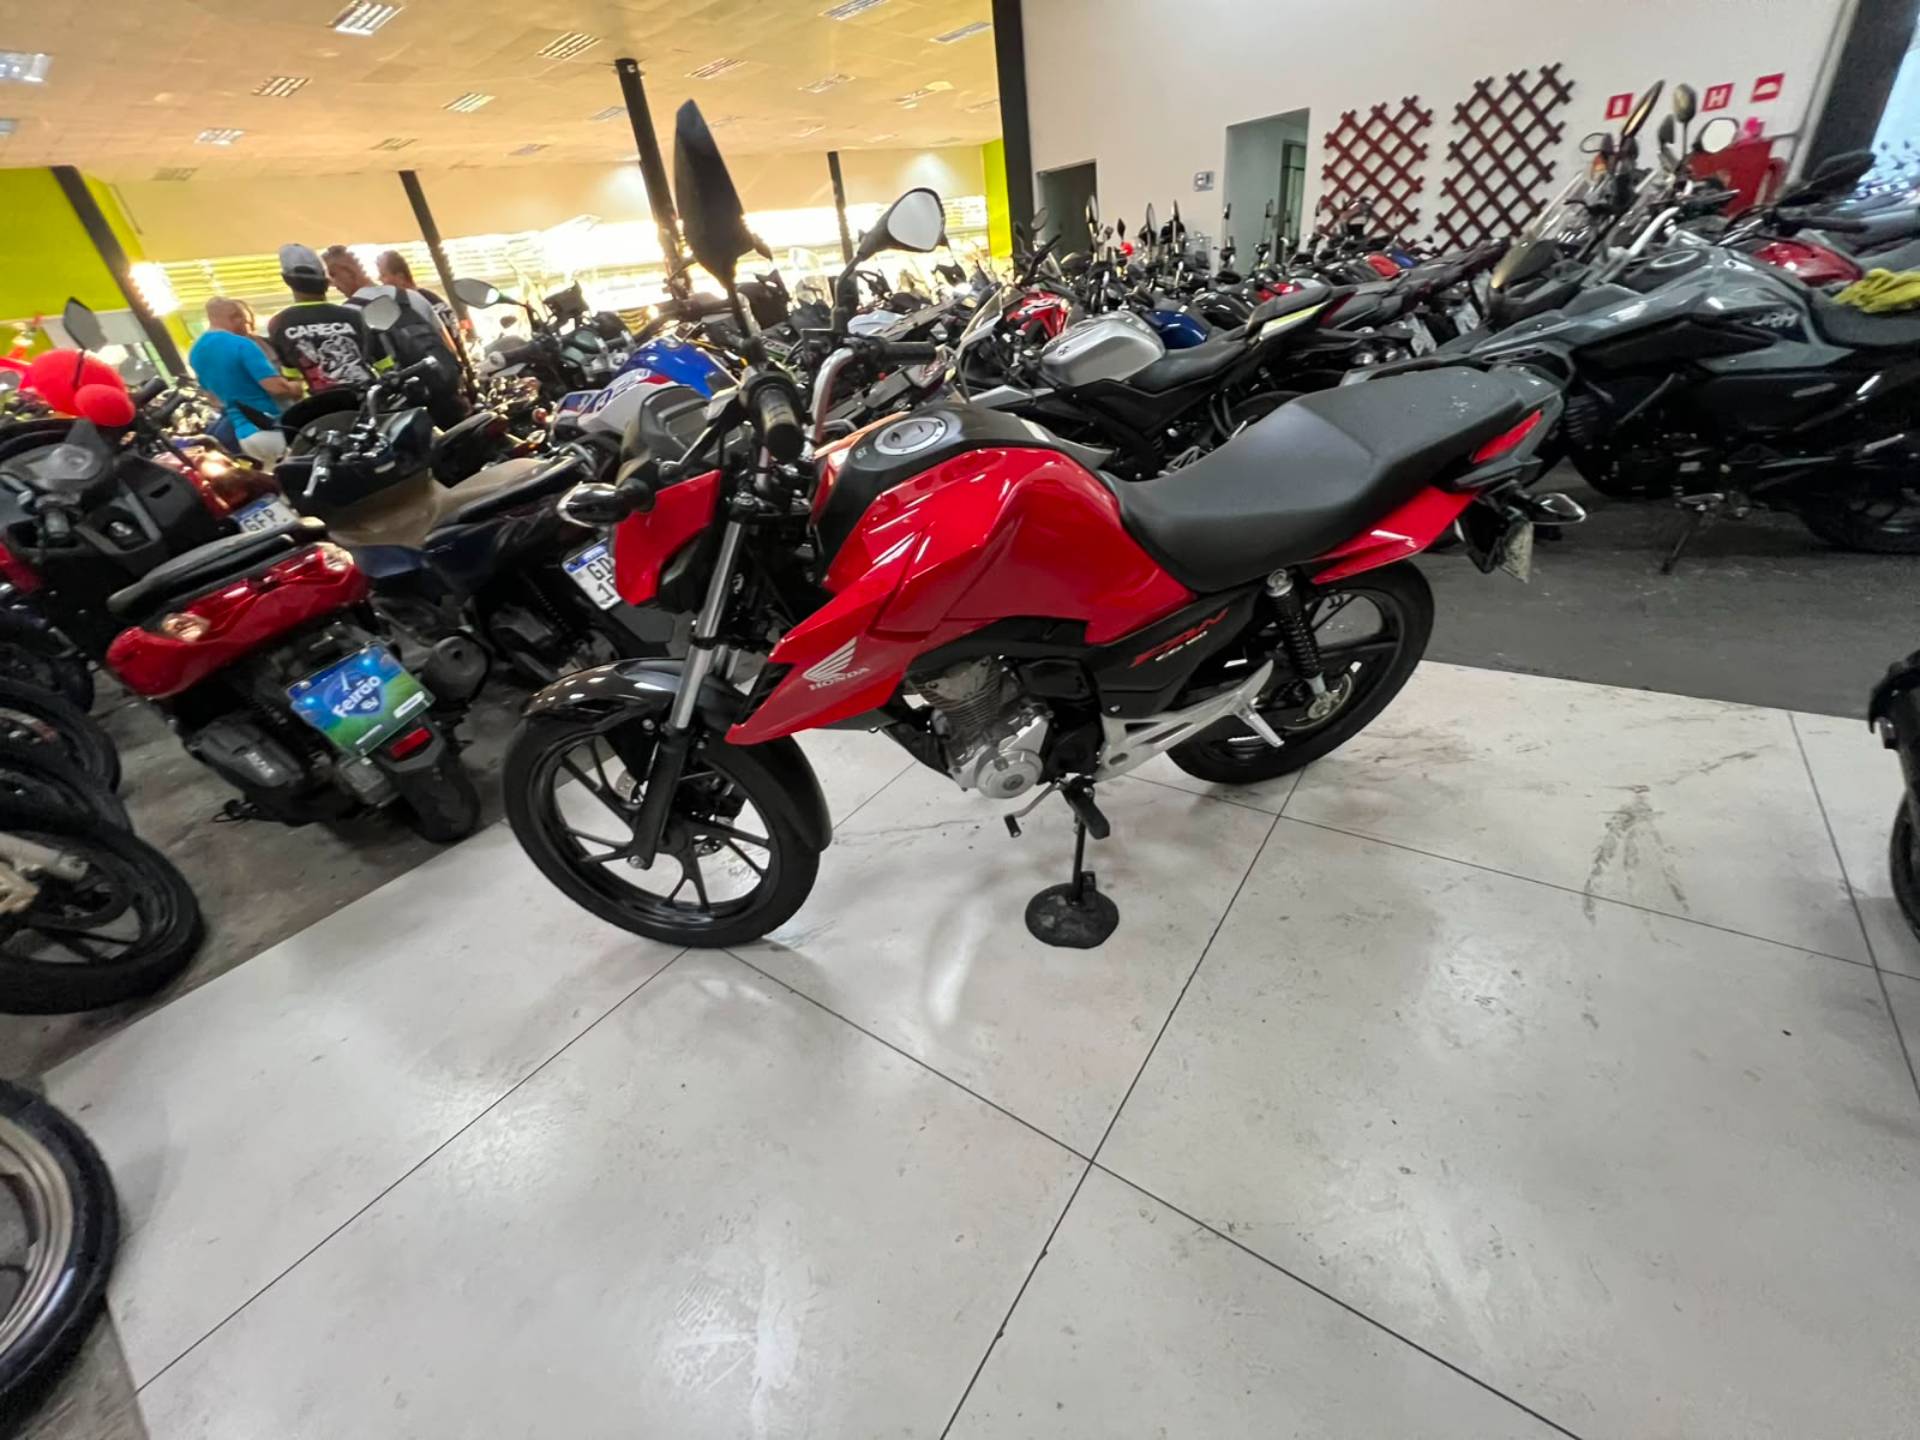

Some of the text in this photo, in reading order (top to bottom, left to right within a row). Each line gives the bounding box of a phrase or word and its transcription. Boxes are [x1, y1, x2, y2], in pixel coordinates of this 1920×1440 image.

[284, 322, 356, 339] CARECA
[808, 667, 871, 691] HONDA
[331, 675, 381, 718] Feirão
